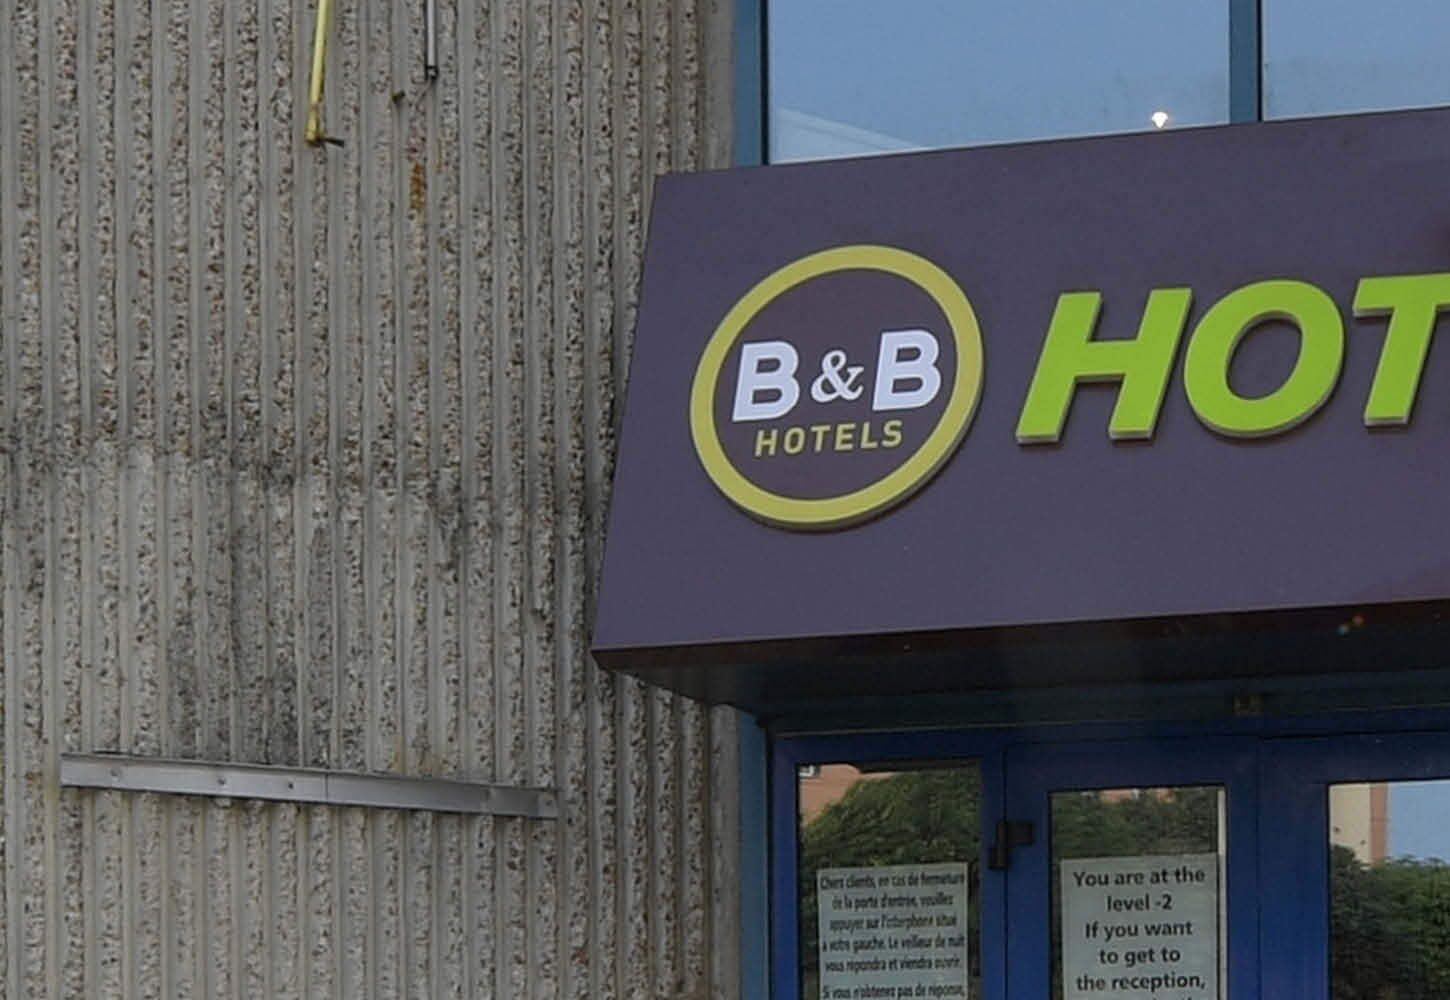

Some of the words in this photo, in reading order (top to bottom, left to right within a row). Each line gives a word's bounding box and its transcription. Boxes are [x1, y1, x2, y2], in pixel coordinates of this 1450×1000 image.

[731, 328, 942, 422] B&B
[754, 419, 904, 457] HOTELS
[1073, 870, 1109, 888] You
[1114, 872, 1144, 885] are
[1149, 868, 1167, 884] at
[1174, 866, 1205, 883] the
[1107, 894, 1150, 912] level
[1155, 894, 1172, 910] -2
[1085, 921, 1099, 939] If
[1104, 924, 1138, 942] you
[1144, 921, 1193, 936] want
[1100, 949, 1119, 964] to
[1124, 949, 1155, 967] get
[1161, 948, 1181, 962] to
[1077, 974, 1106, 991] the
[1111, 972, 1206, 993] reception,
